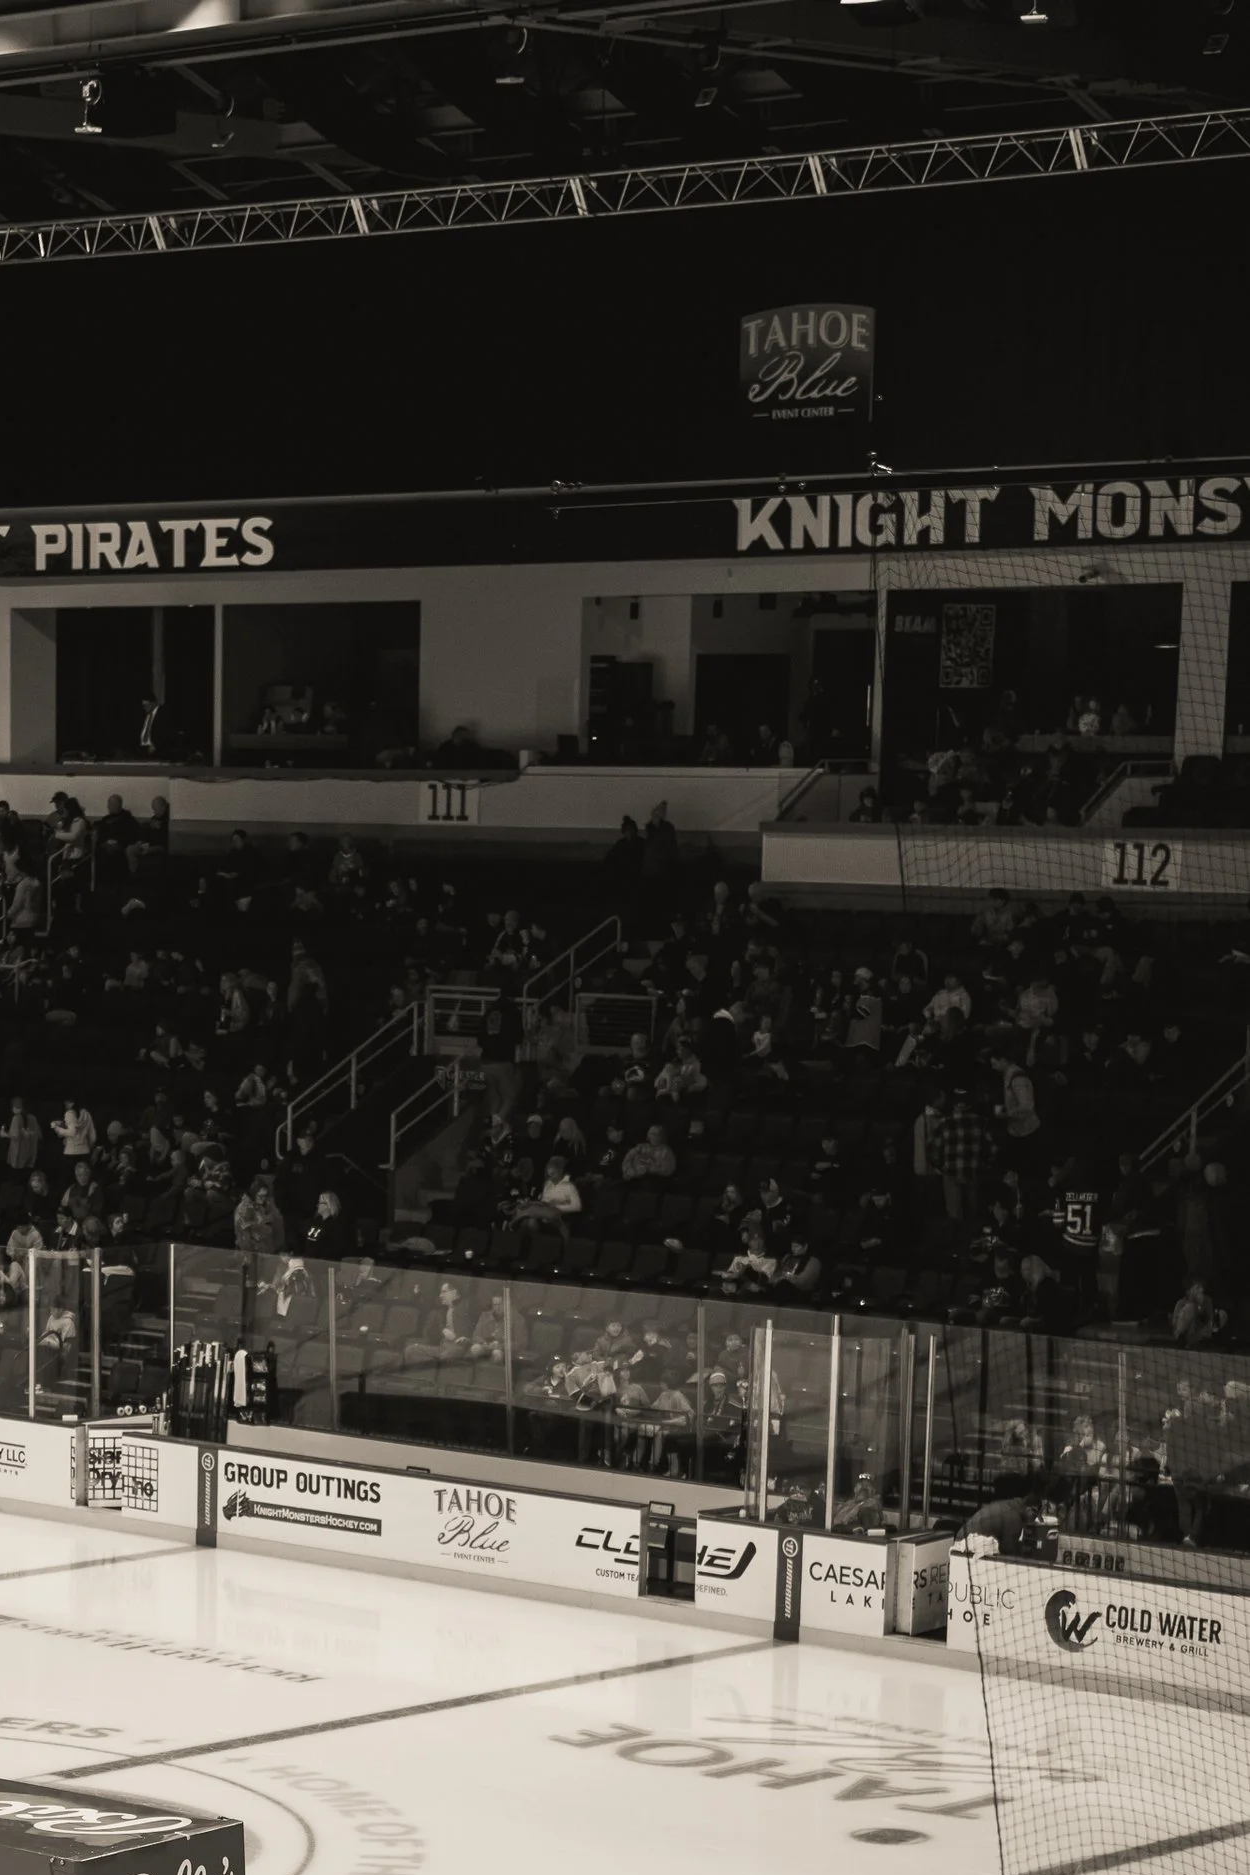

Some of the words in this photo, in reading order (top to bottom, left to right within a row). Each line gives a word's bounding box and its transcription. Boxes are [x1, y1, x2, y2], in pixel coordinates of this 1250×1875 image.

[743, 309, 870, 357] TAHOE
[748, 351, 859, 403] Blue
[772, 408, 799, 420] EVENT
[801, 406, 835, 417] CENTER
[733, 488, 1001, 553] KNIGHT
[33, 517, 275, 571] PIRATES
[427, 784, 469, 822] 111
[1112, 843, 1173, 888] 112
[1066, 1204, 1093, 1236] 51
[6, 1449, 26, 1464] LLC
[224, 1461, 288, 1490] GROUP
[295, 1471, 382, 1504] OUTINGS
[434, 1488, 517, 1526] TAHOE
[437, 1515, 511, 1552] Blue
[453, 1552, 472, 1561] EVENT
[473, 1554, 496, 1564] CENTER
[595, 1567, 625, 1581] CUSTOM
[1105, 1603, 1152, 1634] COLD
[1158, 1611, 1222, 1645] WATER
[1115, 1634, 1165, 1650] BREWERY
[1168, 1642, 1176, 1652] &
[1180, 1644, 1210, 1657] GRILL
[549, 1721, 1015, 1819] TAHOE
